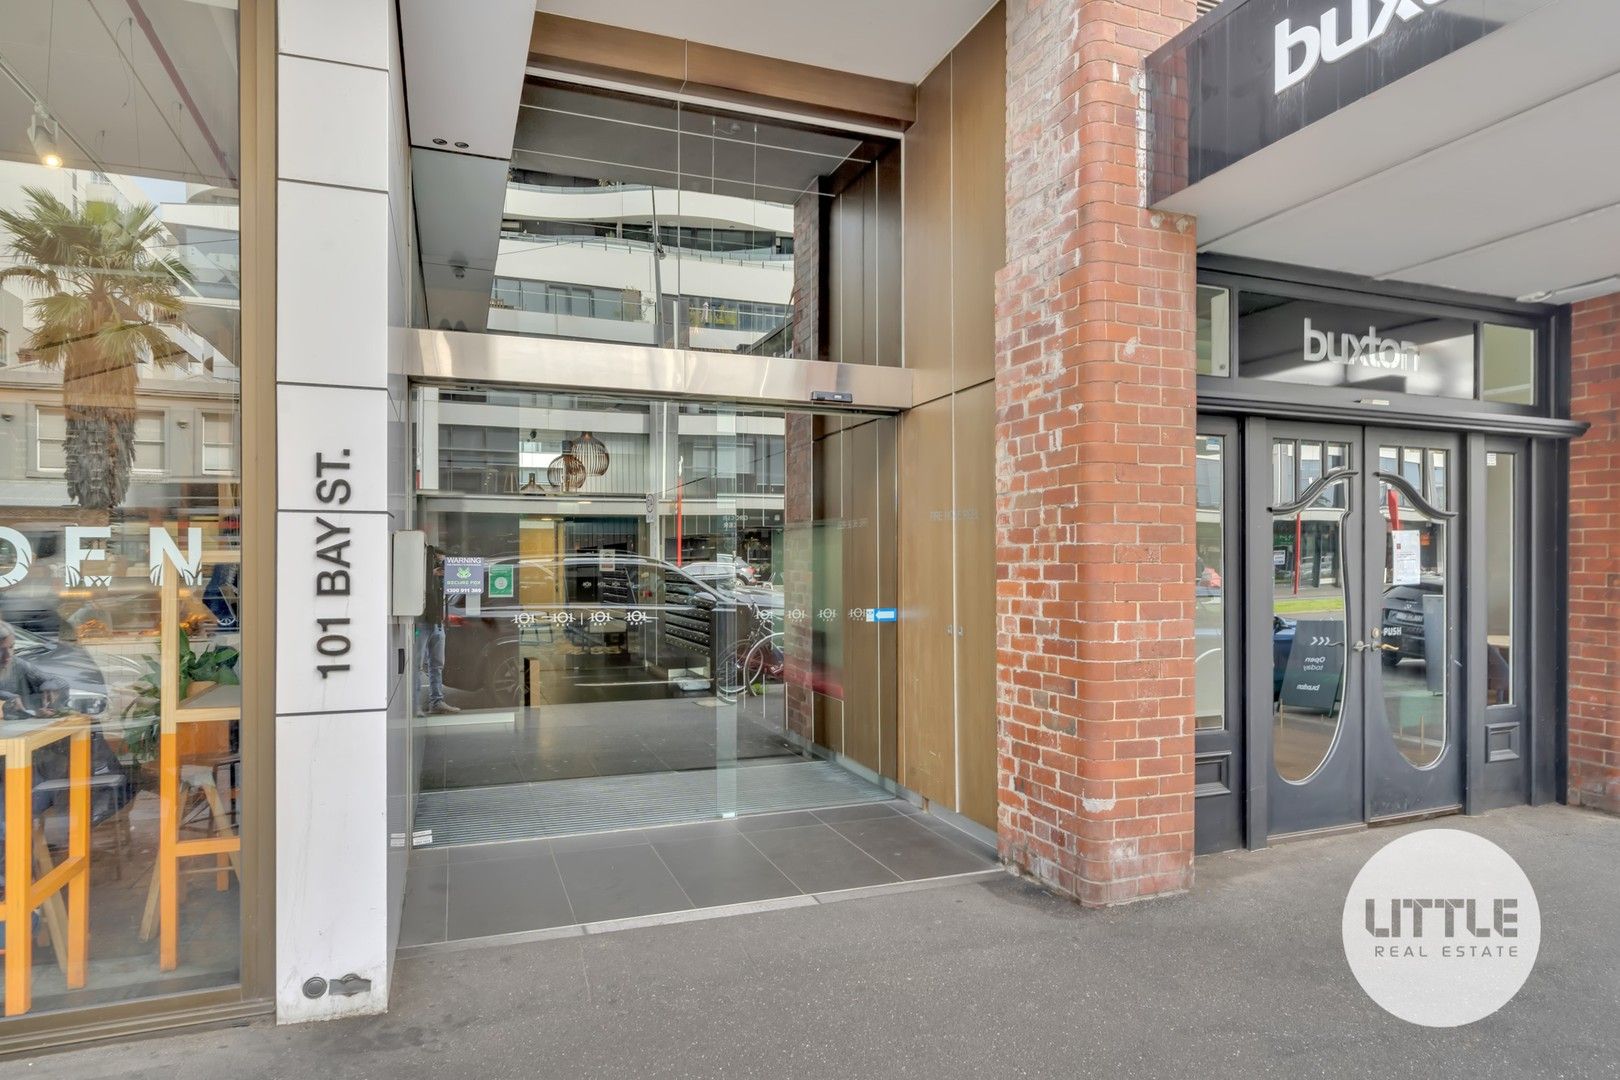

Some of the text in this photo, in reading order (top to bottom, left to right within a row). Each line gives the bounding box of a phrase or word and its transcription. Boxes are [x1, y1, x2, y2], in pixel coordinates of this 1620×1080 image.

[1274, 0, 1447, 94] bux
[1303, 317, 1420, 371] buxton
[316, 448, 352, 679] 101 BAY ST.
[1383, 626, 1402, 637] PUSH
